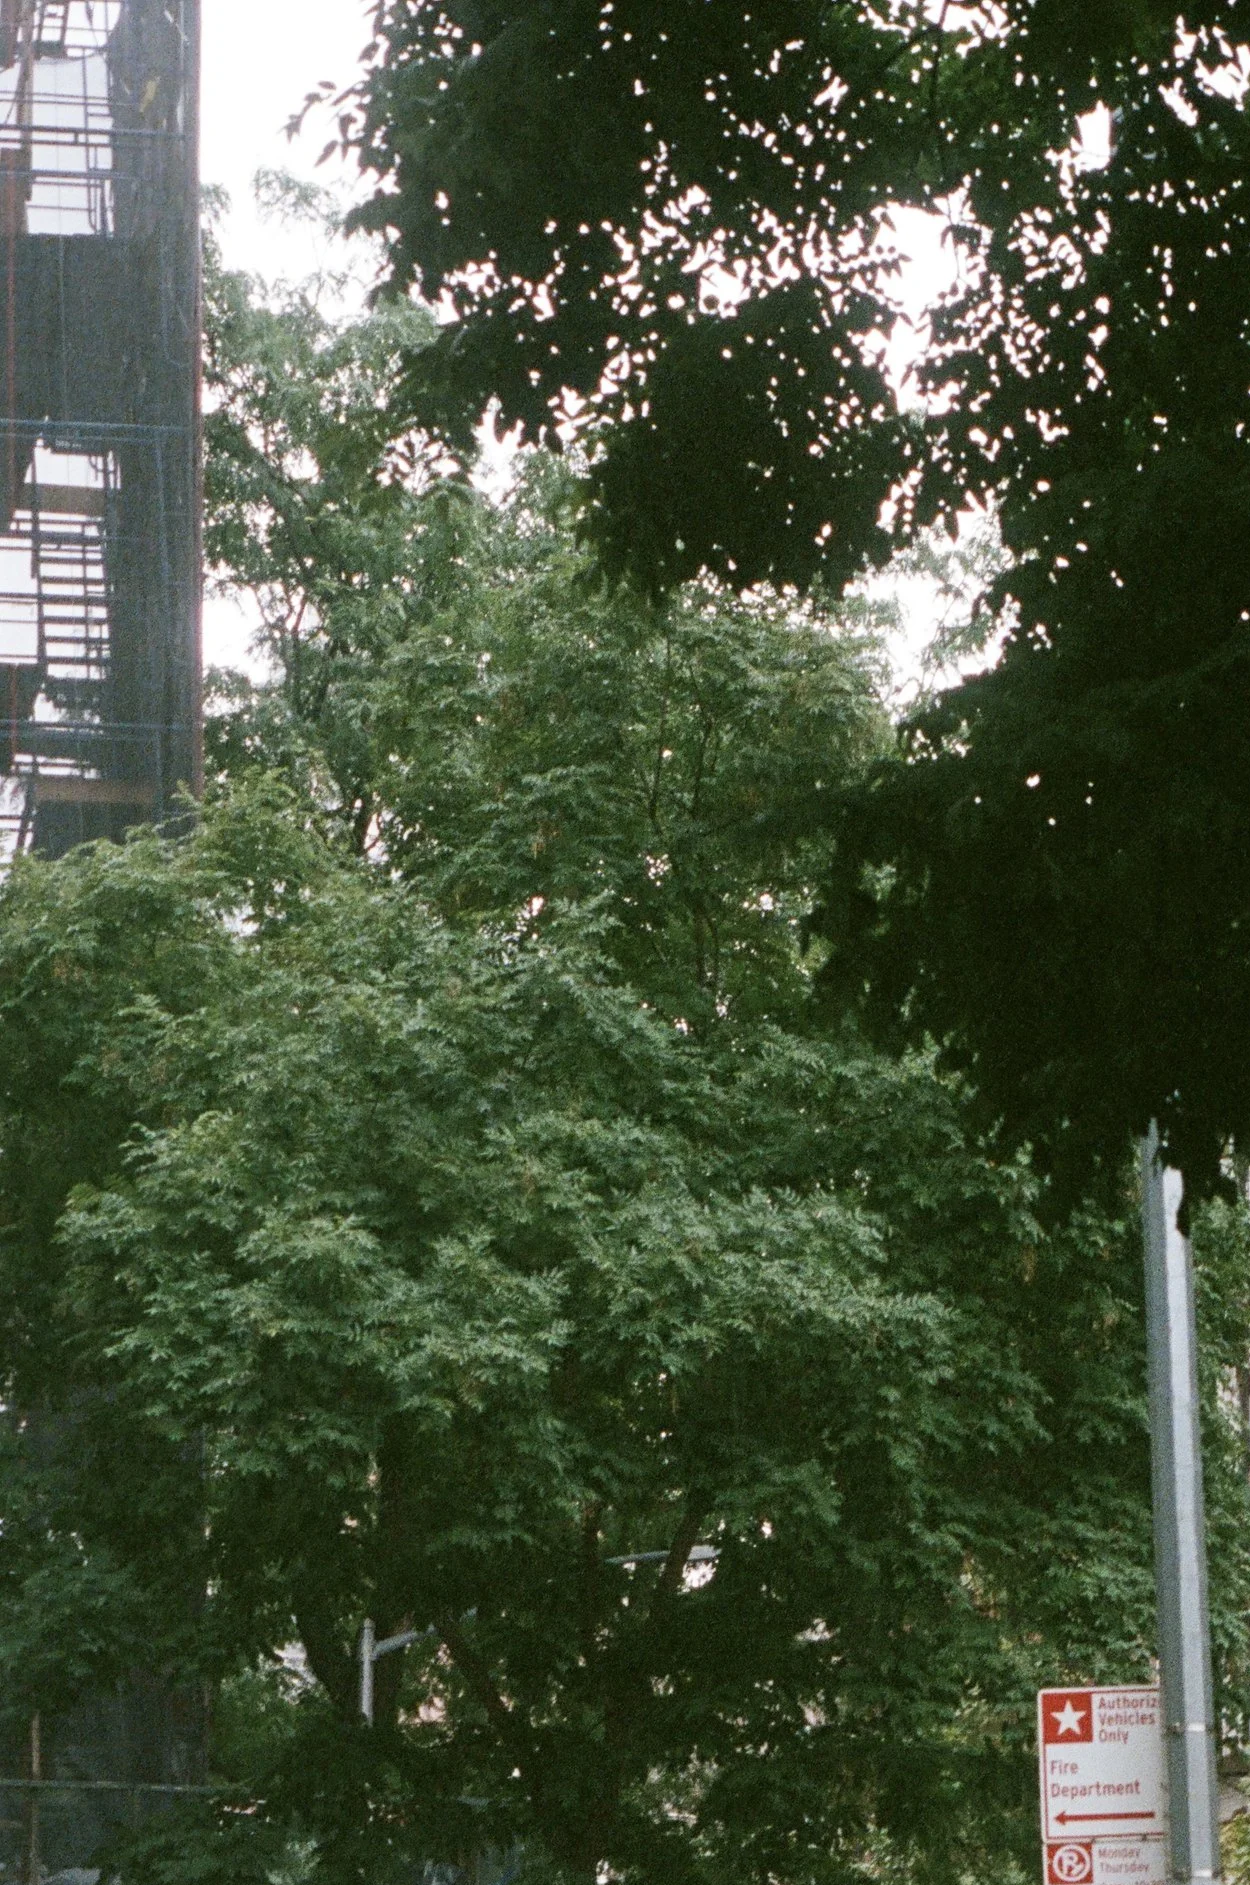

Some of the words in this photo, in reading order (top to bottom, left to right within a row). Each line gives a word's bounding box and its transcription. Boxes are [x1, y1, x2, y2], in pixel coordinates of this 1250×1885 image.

[1099, 1694, 1161, 1710] Authoriz
[1098, 1711, 1156, 1727] Vehicles
[1099, 1728, 1129, 1744] Only
[1050, 1759, 1079, 1775] Fire
[1050, 1779, 1141, 1799] Department
[1098, 1847, 1141, 1860] Monday
[1100, 1861, 1151, 1874] Thursday
